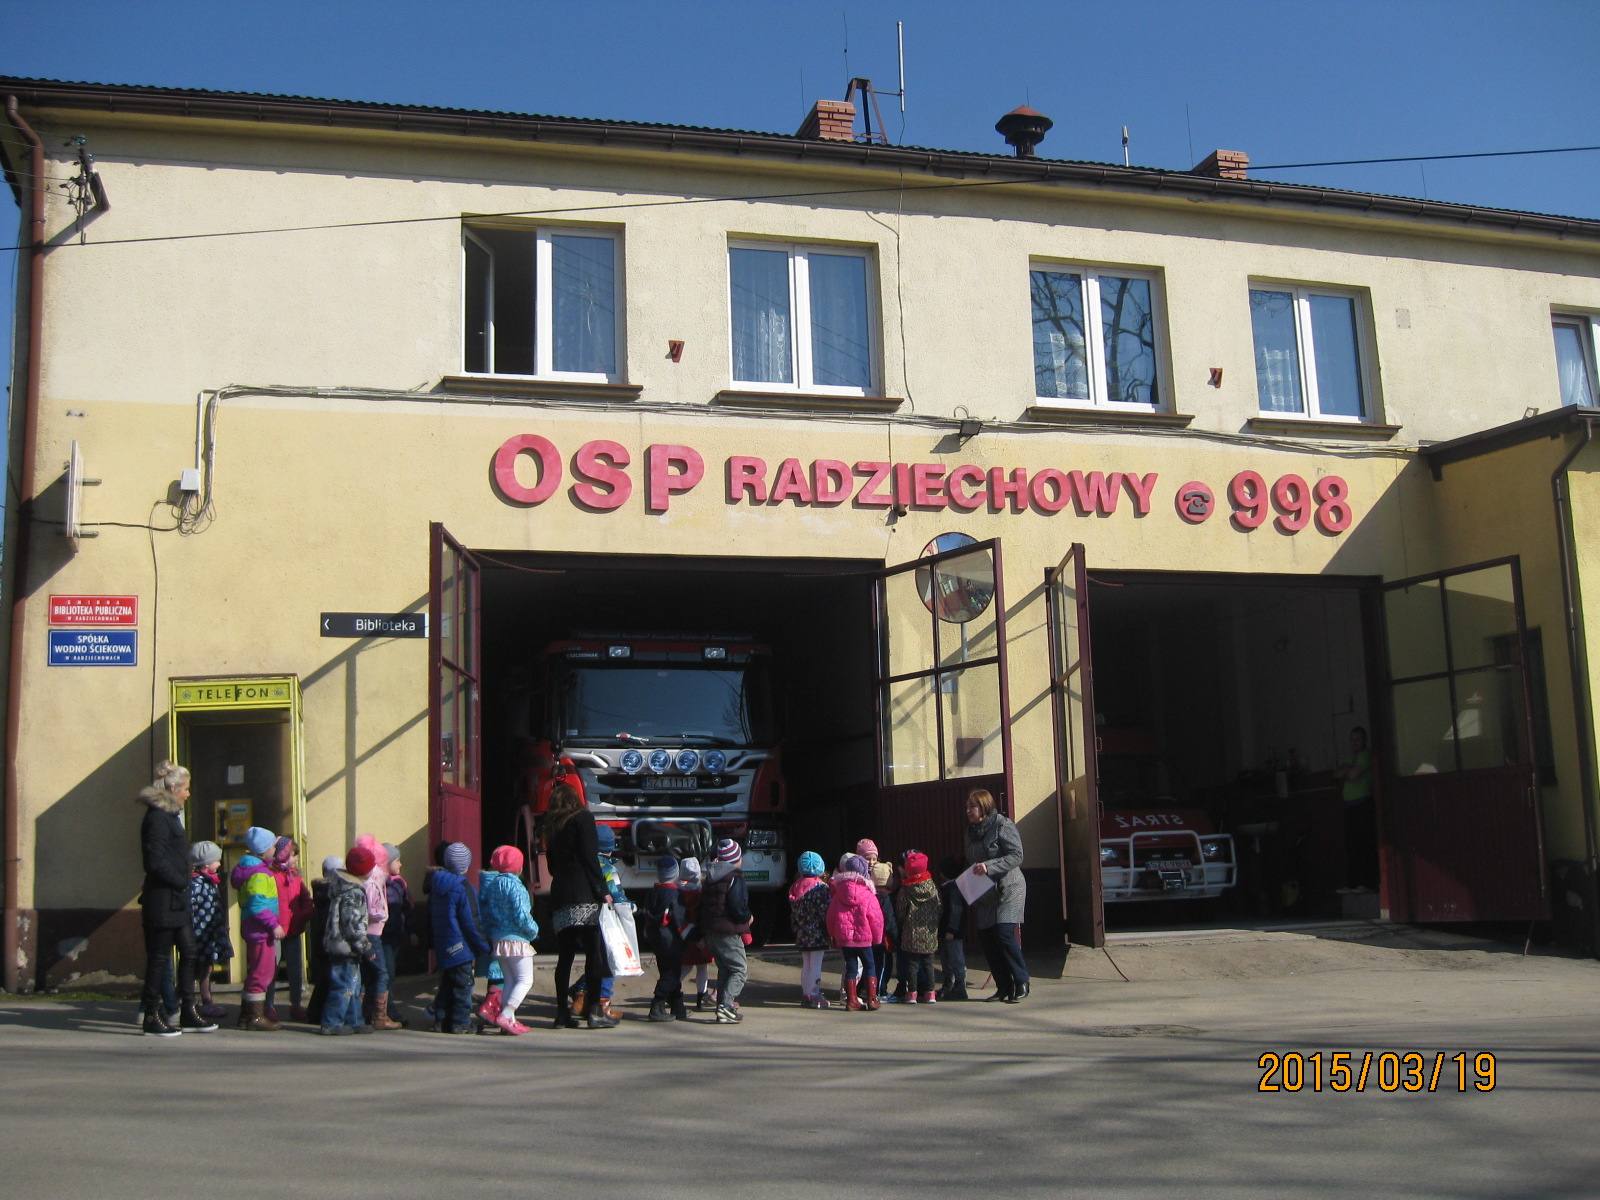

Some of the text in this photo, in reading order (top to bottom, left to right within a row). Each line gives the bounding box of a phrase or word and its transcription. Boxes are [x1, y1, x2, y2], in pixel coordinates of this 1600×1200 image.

[491, 434, 1352, 532] OSP RADZIECHOWY 998
[54, 605, 133, 615] BIBLIOTEKA PUBLICZNA
[355, 618, 416, 631] Biblioteka
[77, 634, 109, 643] SPÓŁKA
[54, 643, 132, 653] WODNO ŚCIEKOWA
[198, 688, 269, 700] TELEFON
